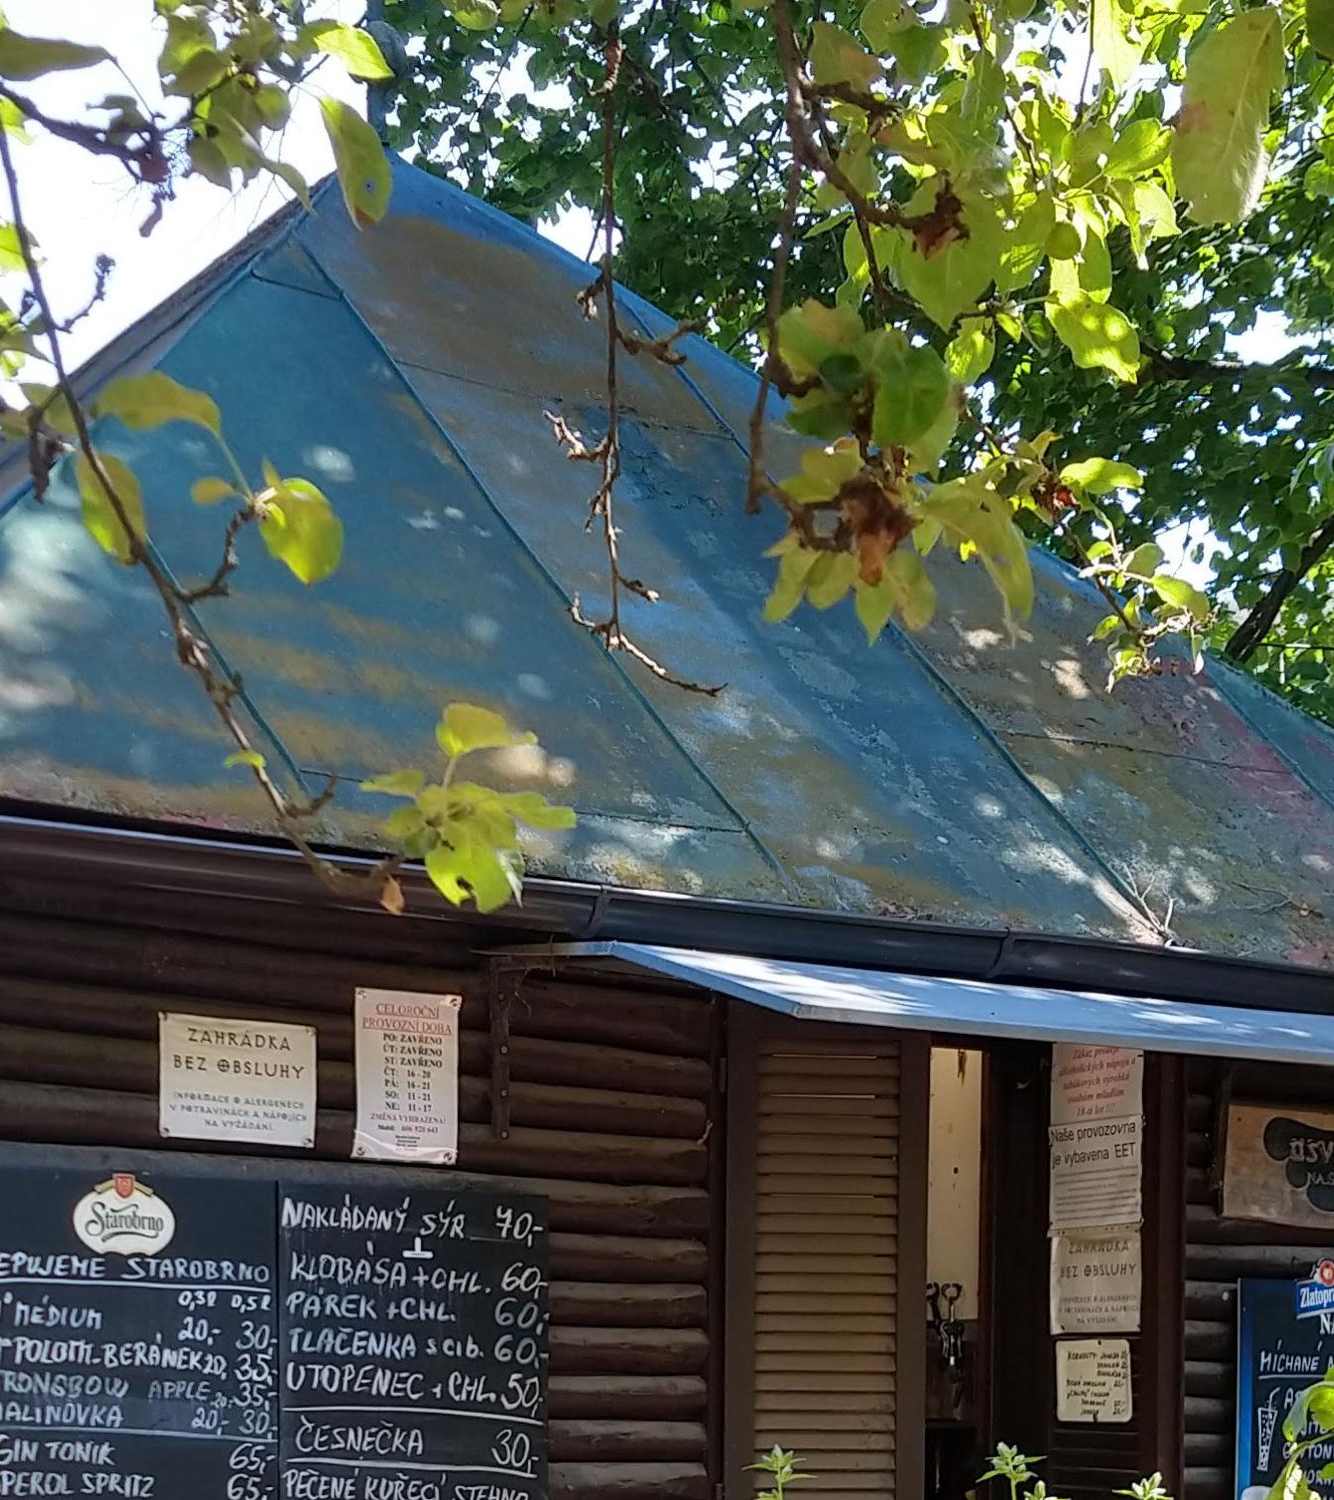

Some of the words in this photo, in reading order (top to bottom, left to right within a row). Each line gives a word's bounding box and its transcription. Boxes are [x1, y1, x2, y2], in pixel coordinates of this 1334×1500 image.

[375, 1002, 440, 1019] CELOROČNÍ
[187, 1026, 291, 1051] ZAHRÁDKA
[362, 1016, 420, 1033] PROVOZNÍ
[422, 1021, 452, 1036] DOBA
[400, 1032, 443, 1045] ZAVŘENO
[400, 1044, 443, 1057] ZAVŘENO
[400, 1056, 443, 1069] ZAVŘENO
[173, 1054, 208, 1071] BEZ
[217, 1058, 305, 1079] OBSLUHY
[1050, 1127, 1075, 1142] Naše
[1077, 1121, 1136, 1143] provozovna
[1052, 1152, 1062, 1170] je
[1064, 1148, 1110, 1168] vybavena
[1114, 1142, 1136, 1159] EET
[85, 1200, 165, 1242] Starobrno
[281, 1193, 411, 1233] NAKLÁDANÝ
[420, 1199, 466, 1239] SÝR
[120, 1256, 271, 1283] STAROBRNO
[290, 1240, 407, 1290] KLOBÁSA
[15, 1294, 103, 1330] MÉDIUM
[285, 1286, 378, 1320] PÁREK
[288, 1325, 417, 1361] TLAČENKA
[1259, 1339, 1322, 1373] MÍCHANÉ
[148, 1379, 212, 1401] APPLE
[286, 1361, 425, 1401] UTOPENEC
[295, 1415, 424, 1456] ČESNEČKA
[44, 1440, 116, 1467] TONIK
[80, 1472, 156, 1499] SPRITZ
[282, 1467, 360, 1500] PEČENÉ
